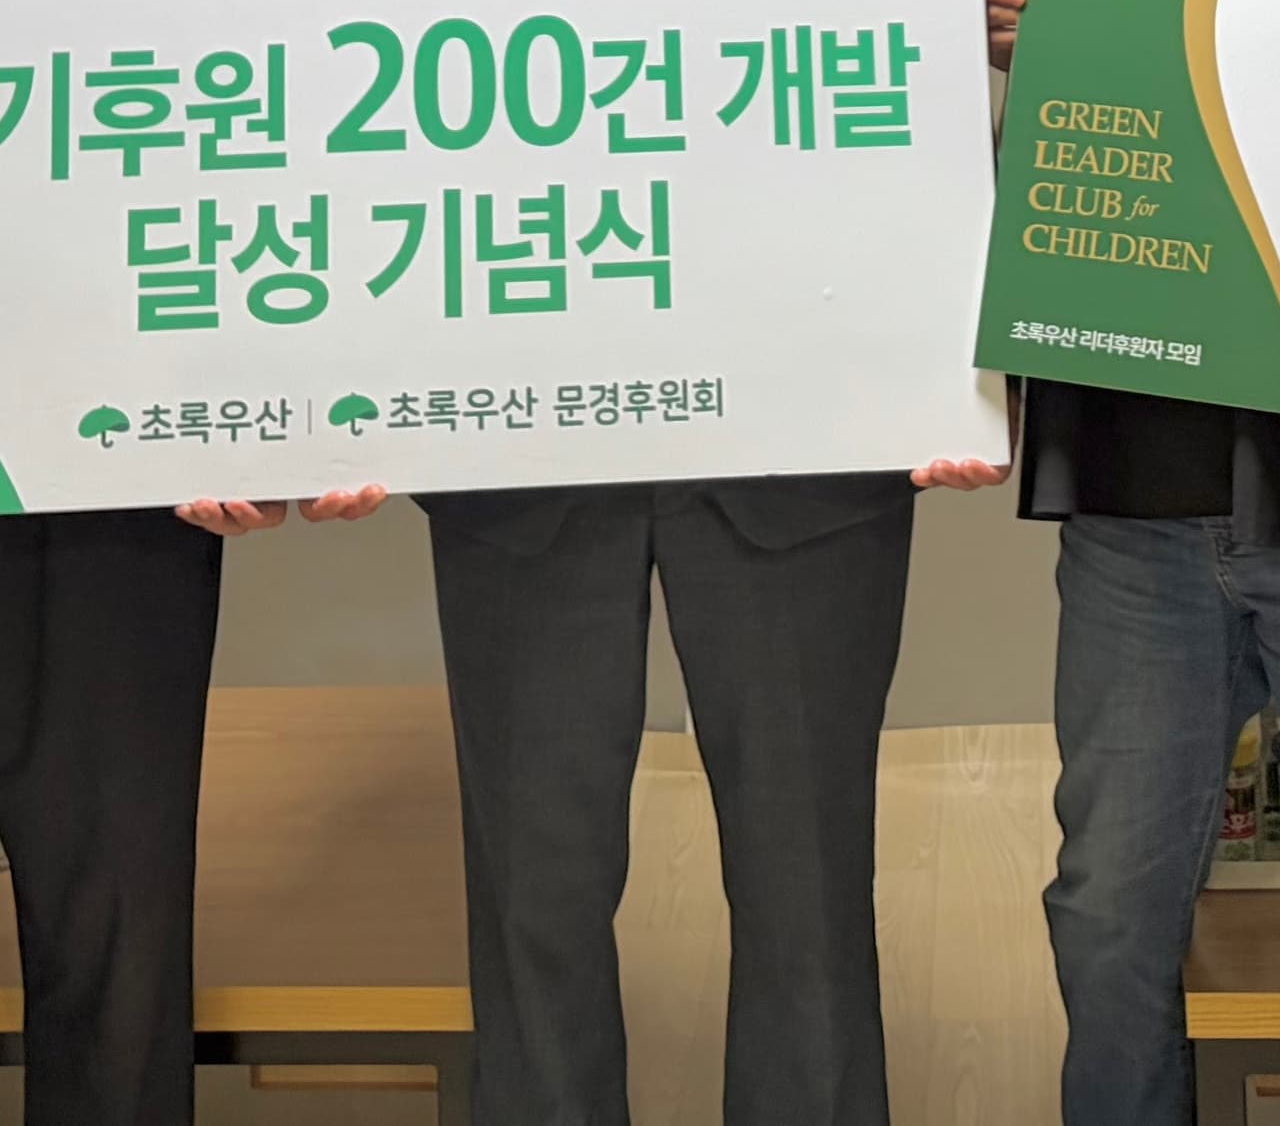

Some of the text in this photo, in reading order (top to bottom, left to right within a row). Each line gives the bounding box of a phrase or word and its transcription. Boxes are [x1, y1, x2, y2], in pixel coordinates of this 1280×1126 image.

[326, 15, 687, 154] 200건
[716, 22, 921, 151] 개발
[1038, 99, 1163, 141] GREEN
[1034, 140, 1174, 183] LEADER
[1028, 181, 1160, 221] CLUB for
[126, 179, 673, 332] 달성 기념식
[1022, 223, 1213, 274] CHILDREN
[1010, 320, 1202, 366] 초록우산 리더후원자 모임
[137, 398, 293, 444] 초록우산
[386, 377, 724, 432] 초록우산 문경후원회
